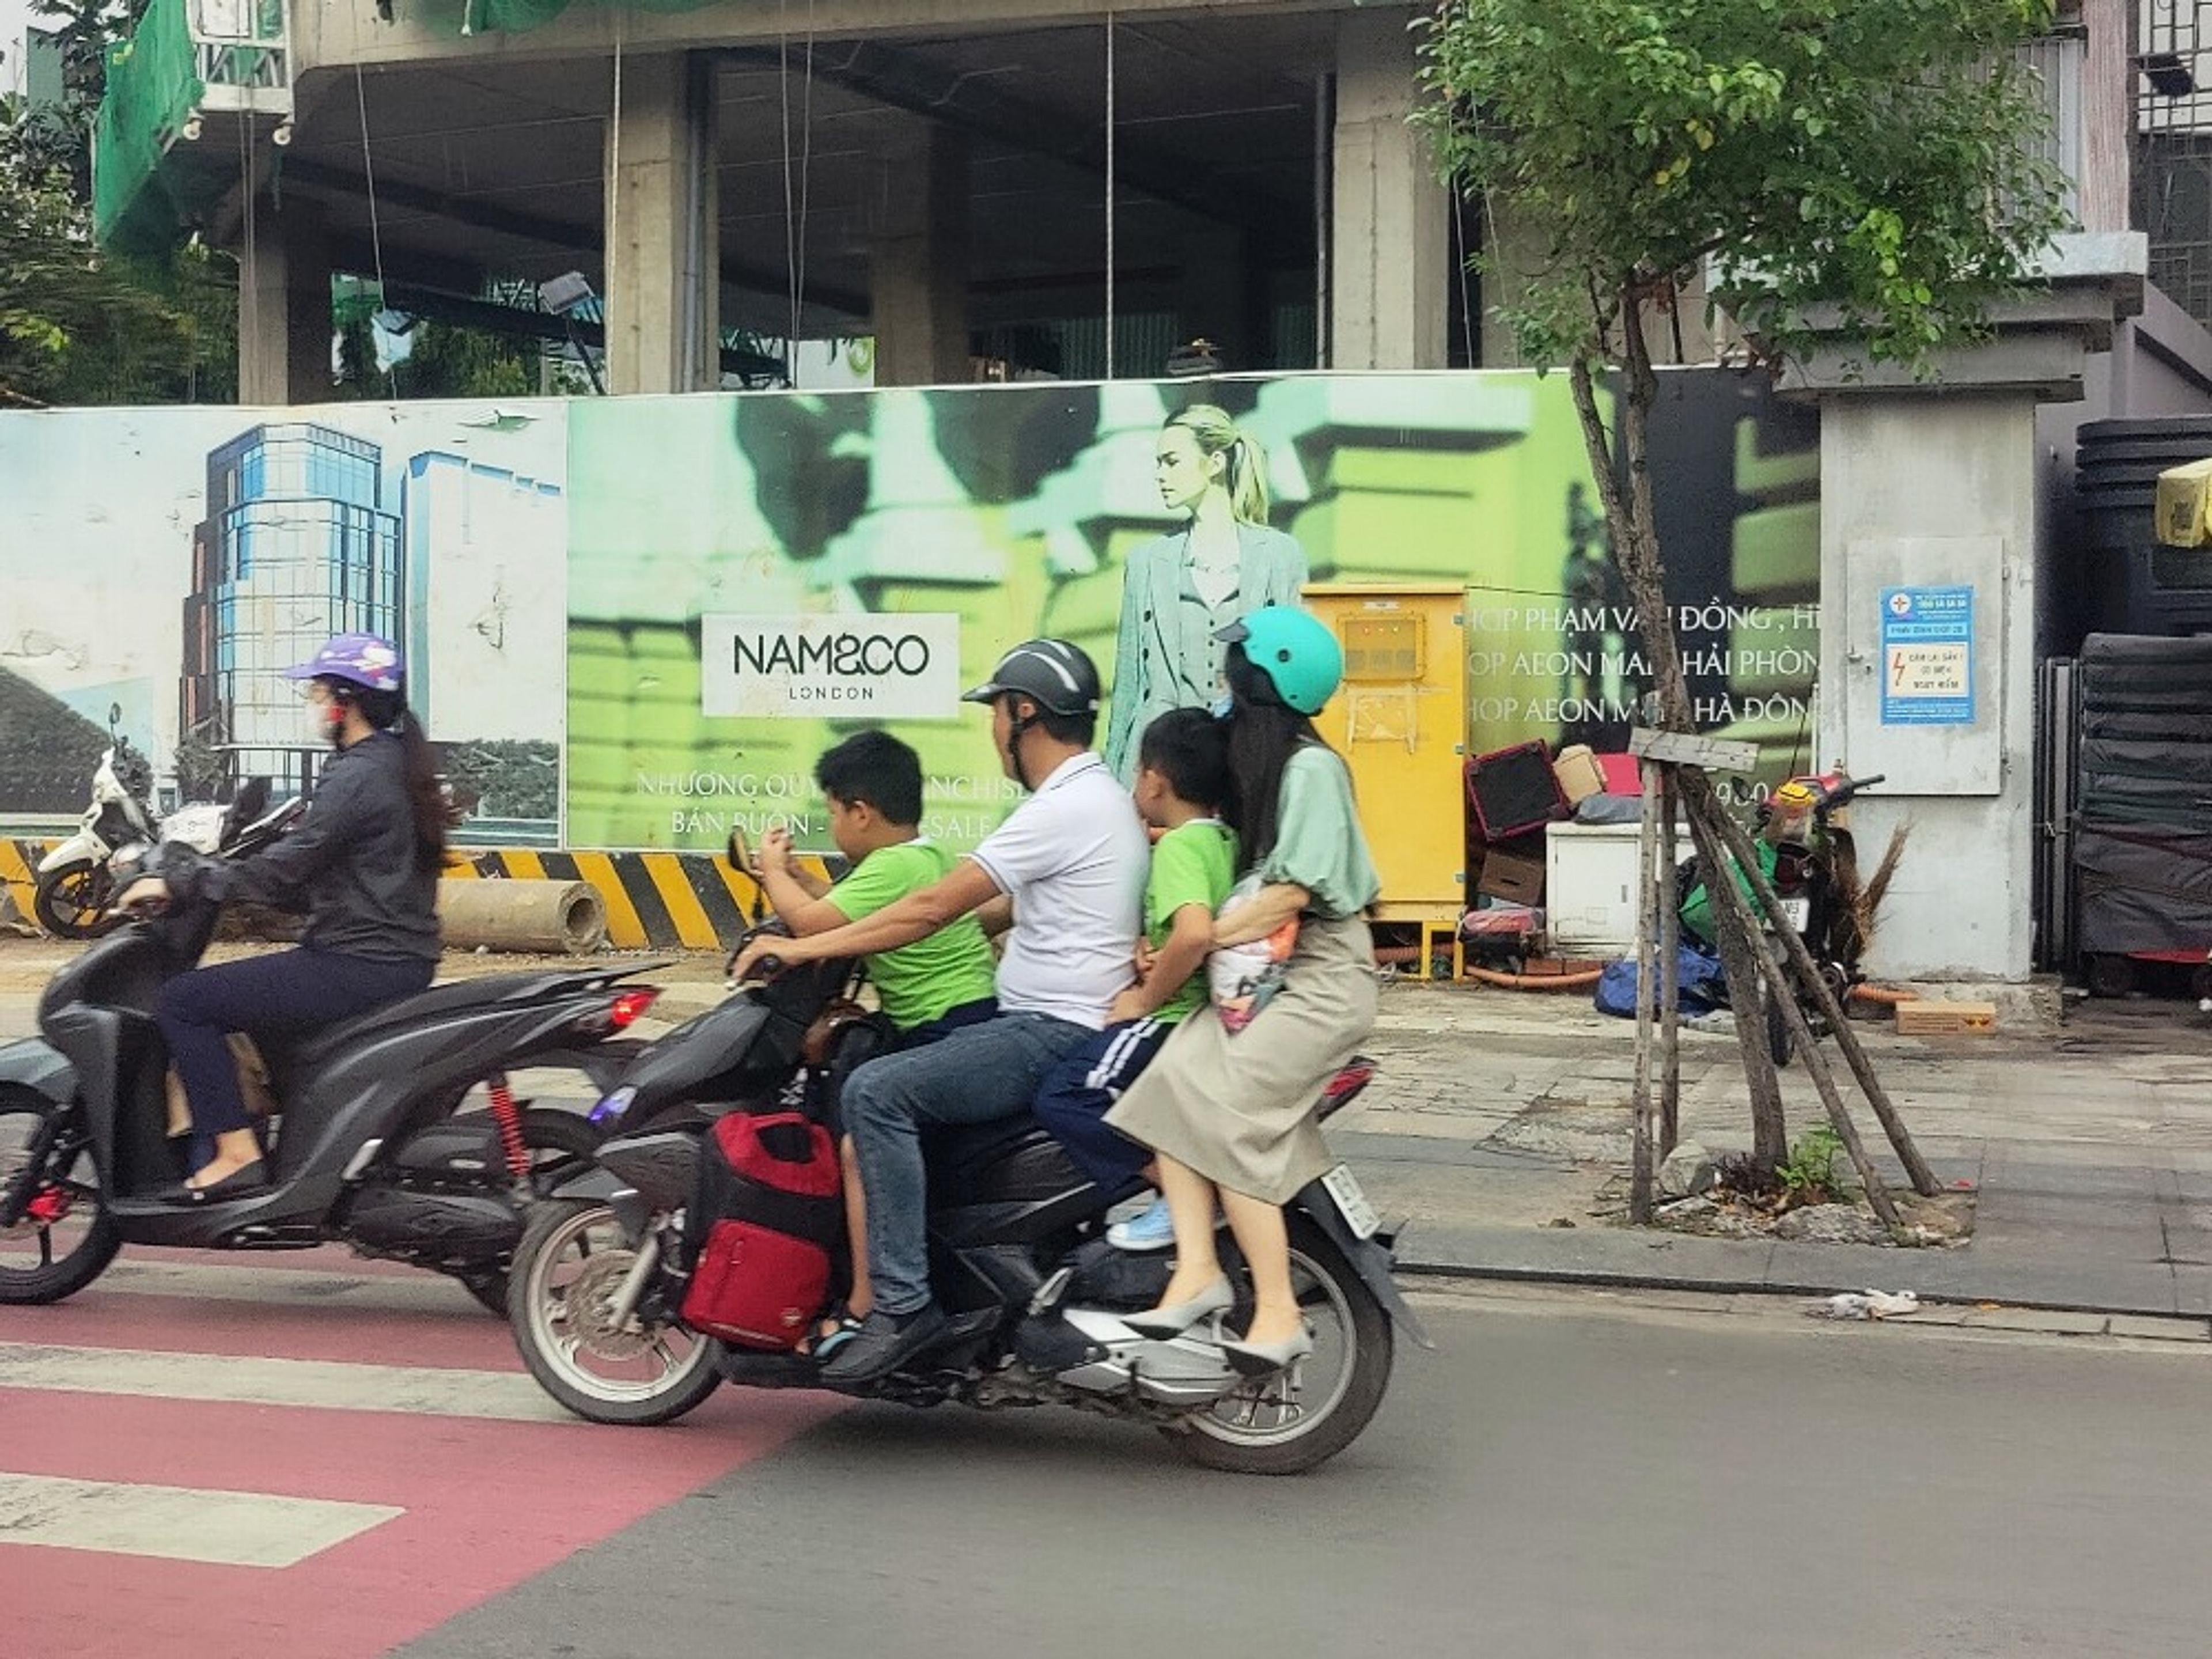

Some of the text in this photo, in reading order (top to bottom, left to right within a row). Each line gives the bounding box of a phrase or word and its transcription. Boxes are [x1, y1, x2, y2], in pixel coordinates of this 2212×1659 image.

[1467, 608, 1518, 630] HOP
[1526, 607, 1605, 638] PHẠM
[1679, 596, 1771, 631] ĐỒNG
[734, 632, 929, 676] NAM&CO
[1512, 652, 1592, 676] AEON
[1683, 642, 1730, 676] HẢI
[1740, 645, 1819, 676] PHÒN
[789, 687, 873, 700] LONDON
[1468, 698, 1518, 722] HOP
[1524, 698, 1605, 722] AEON
[1694, 692, 1736, 722] HÀ
[1743, 692, 1806, 722] ĐÔN
[636, 770, 758, 800] NHƯỢNG
[672, 807, 725, 833] BÁN
